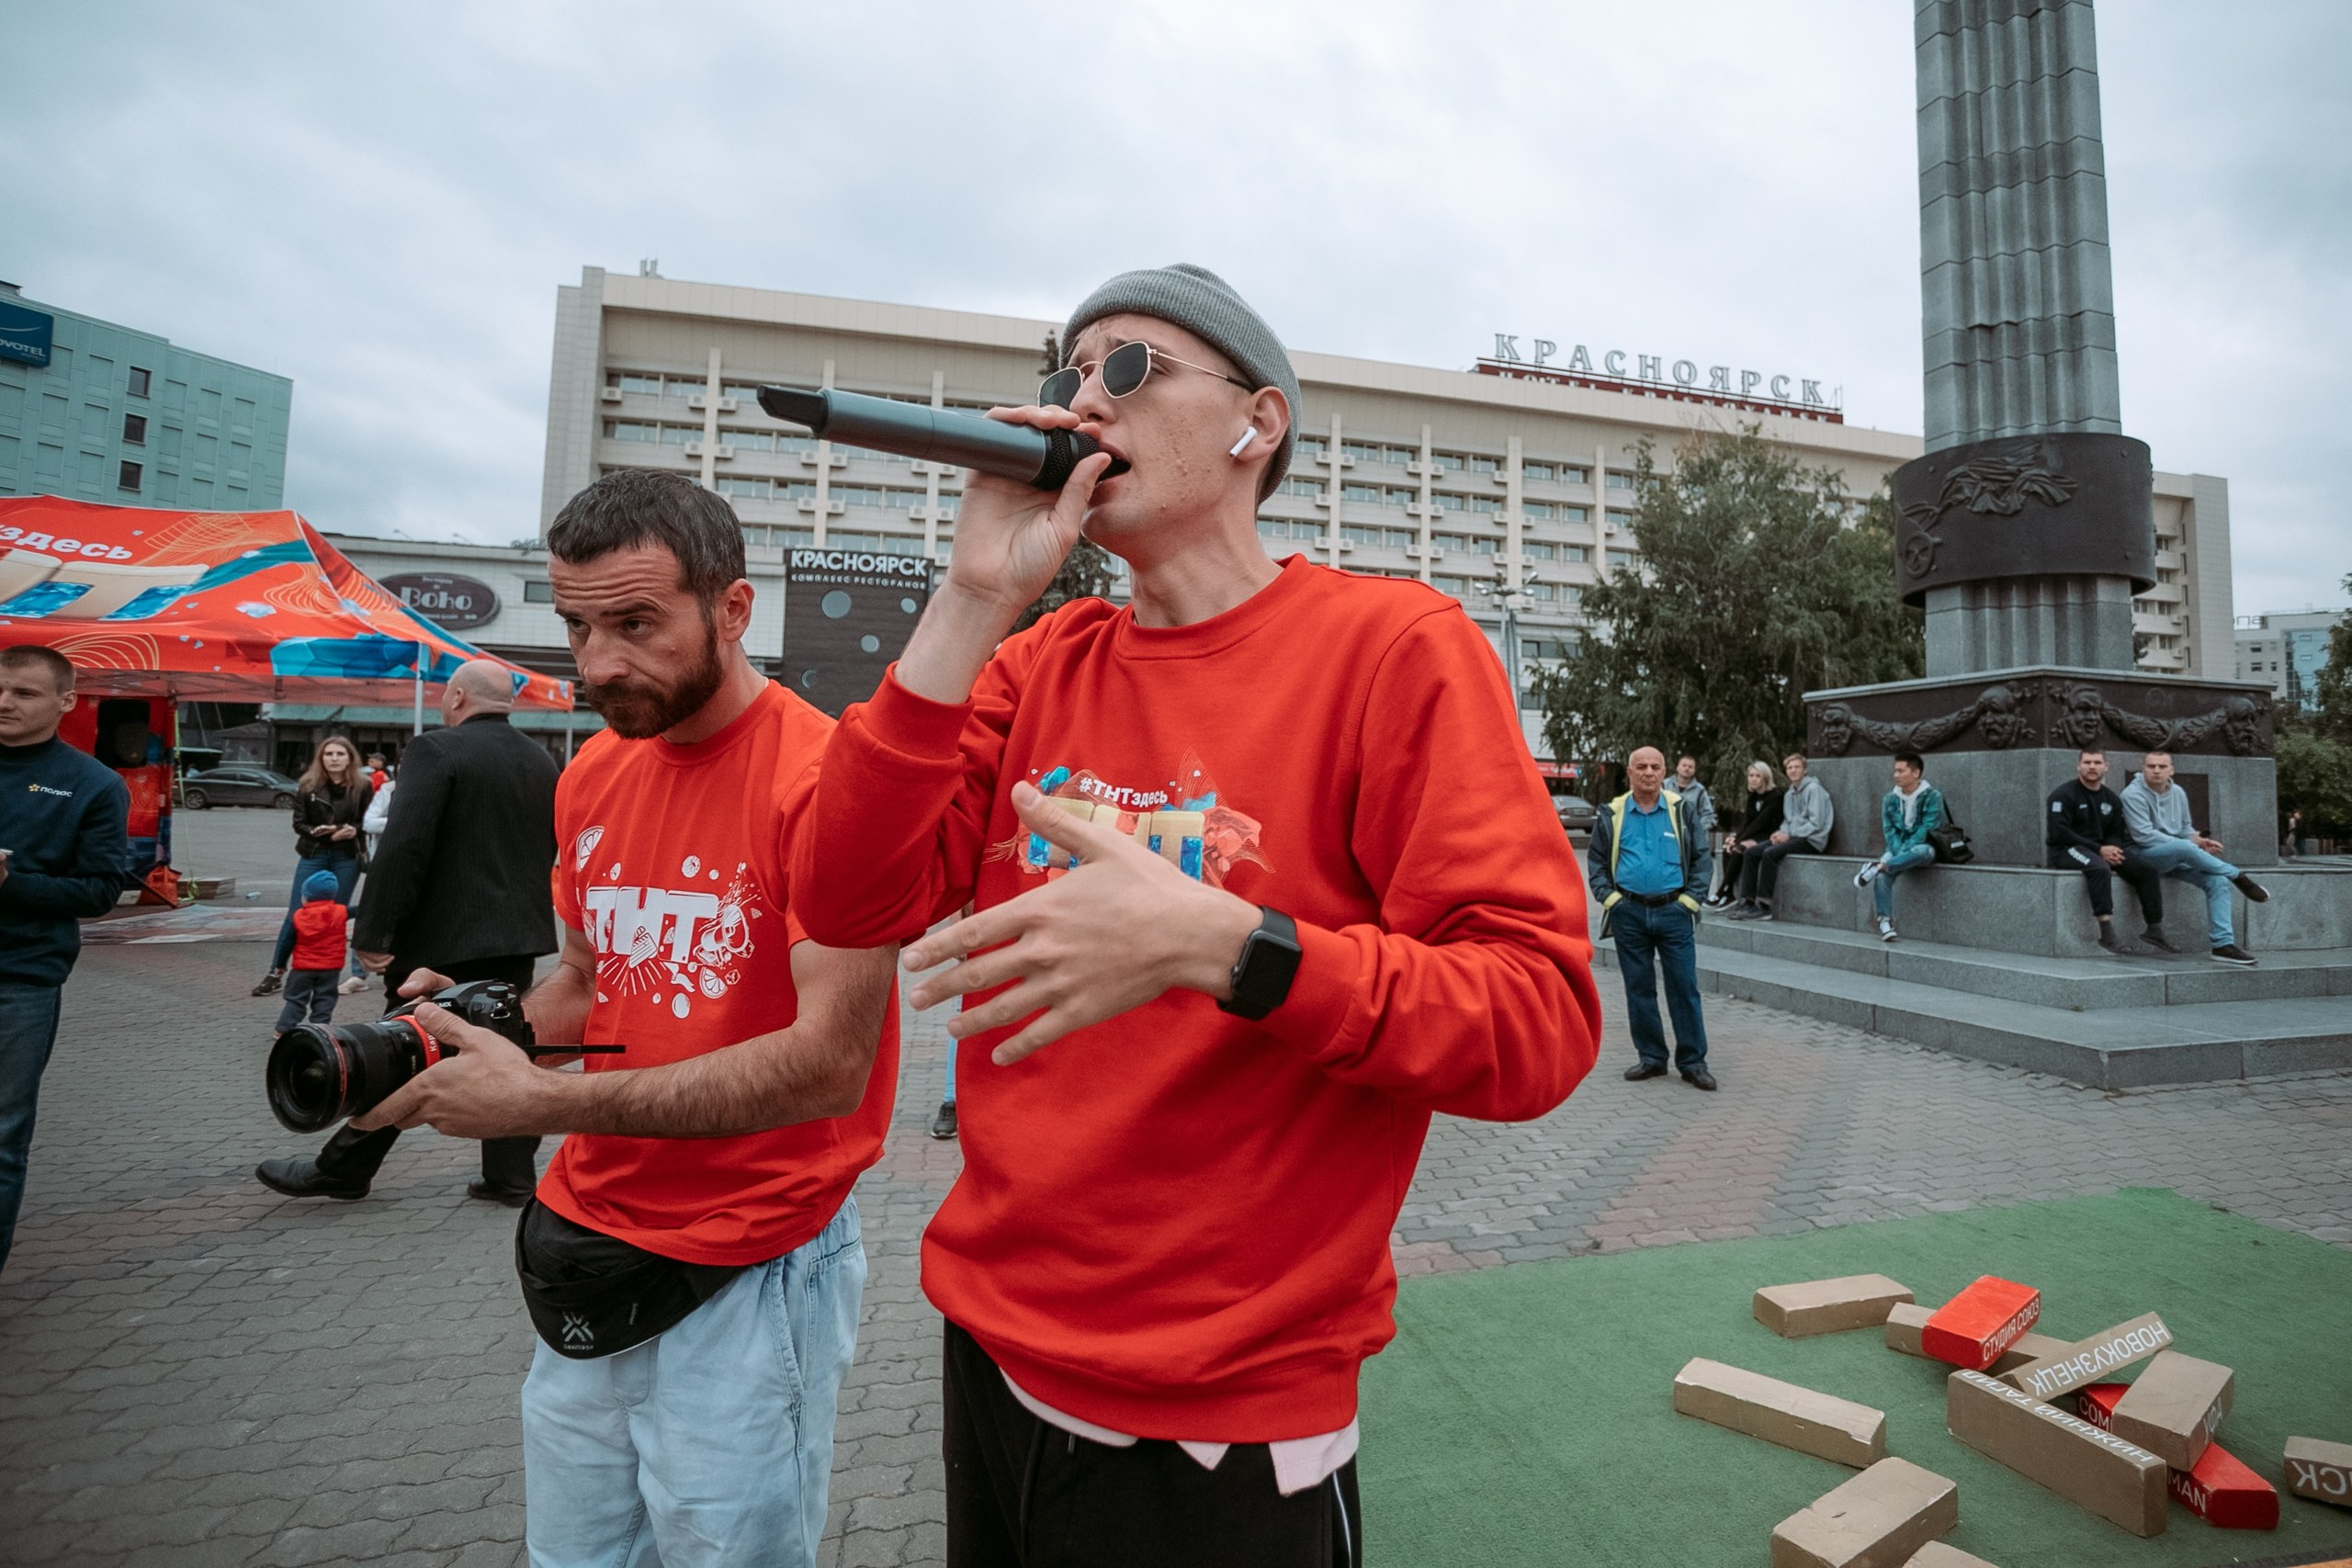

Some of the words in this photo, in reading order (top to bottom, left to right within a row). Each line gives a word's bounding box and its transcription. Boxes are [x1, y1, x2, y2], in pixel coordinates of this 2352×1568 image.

[1495, 333, 1824, 404] КРАСНОЯРСК
[0, 525, 133, 559] здесь
[791, 550, 927, 577] КРАСНОЯРСК
[401, 586, 473, 611] Boho
[791, 573, 852, 584] КОМПЛЕКС
[854, 576, 927, 590] РЕСТОРАНОВ
[1079, 777, 1168, 807] #ТНТздесь
[1983, 1318, 2017, 1361] СТУДИЯ
[2017, 1298, 2040, 1331] СОЮЗ
[2027, 1322, 2171, 1396] НОВОКУЗНЕЦК
[1962, 1371, 2035, 1405] ТАГИЛ
[2034, 1404, 2154, 1462] НИЖНИЙ
[2291, 1461, 2352, 1495] СК
